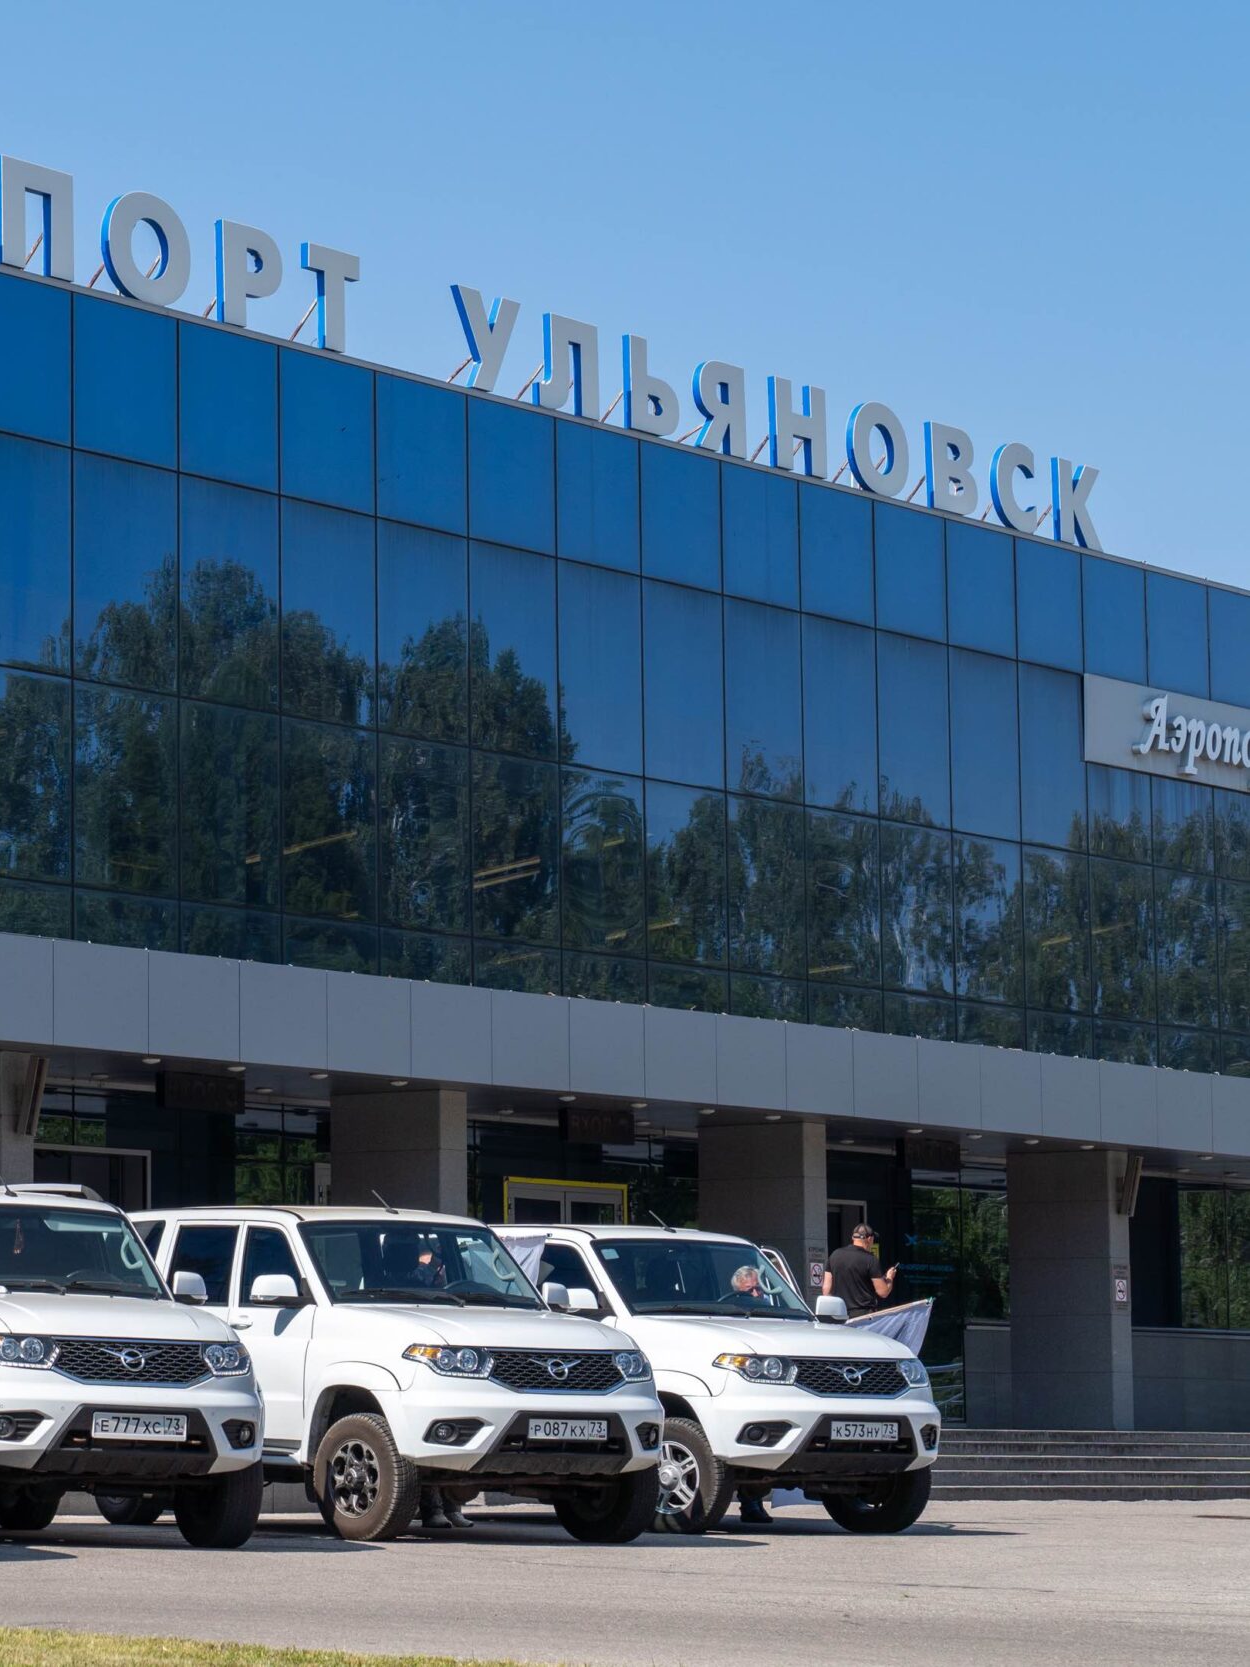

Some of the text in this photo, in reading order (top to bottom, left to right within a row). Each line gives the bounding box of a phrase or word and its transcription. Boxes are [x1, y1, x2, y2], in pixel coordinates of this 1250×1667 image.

[450, 284, 1103, 552] УЛЬЯНОВСК
[166, 1417, 181, 1431] 73
[589, 1421, 603, 1433] 73
[883, 1423, 895, 1435] 73
